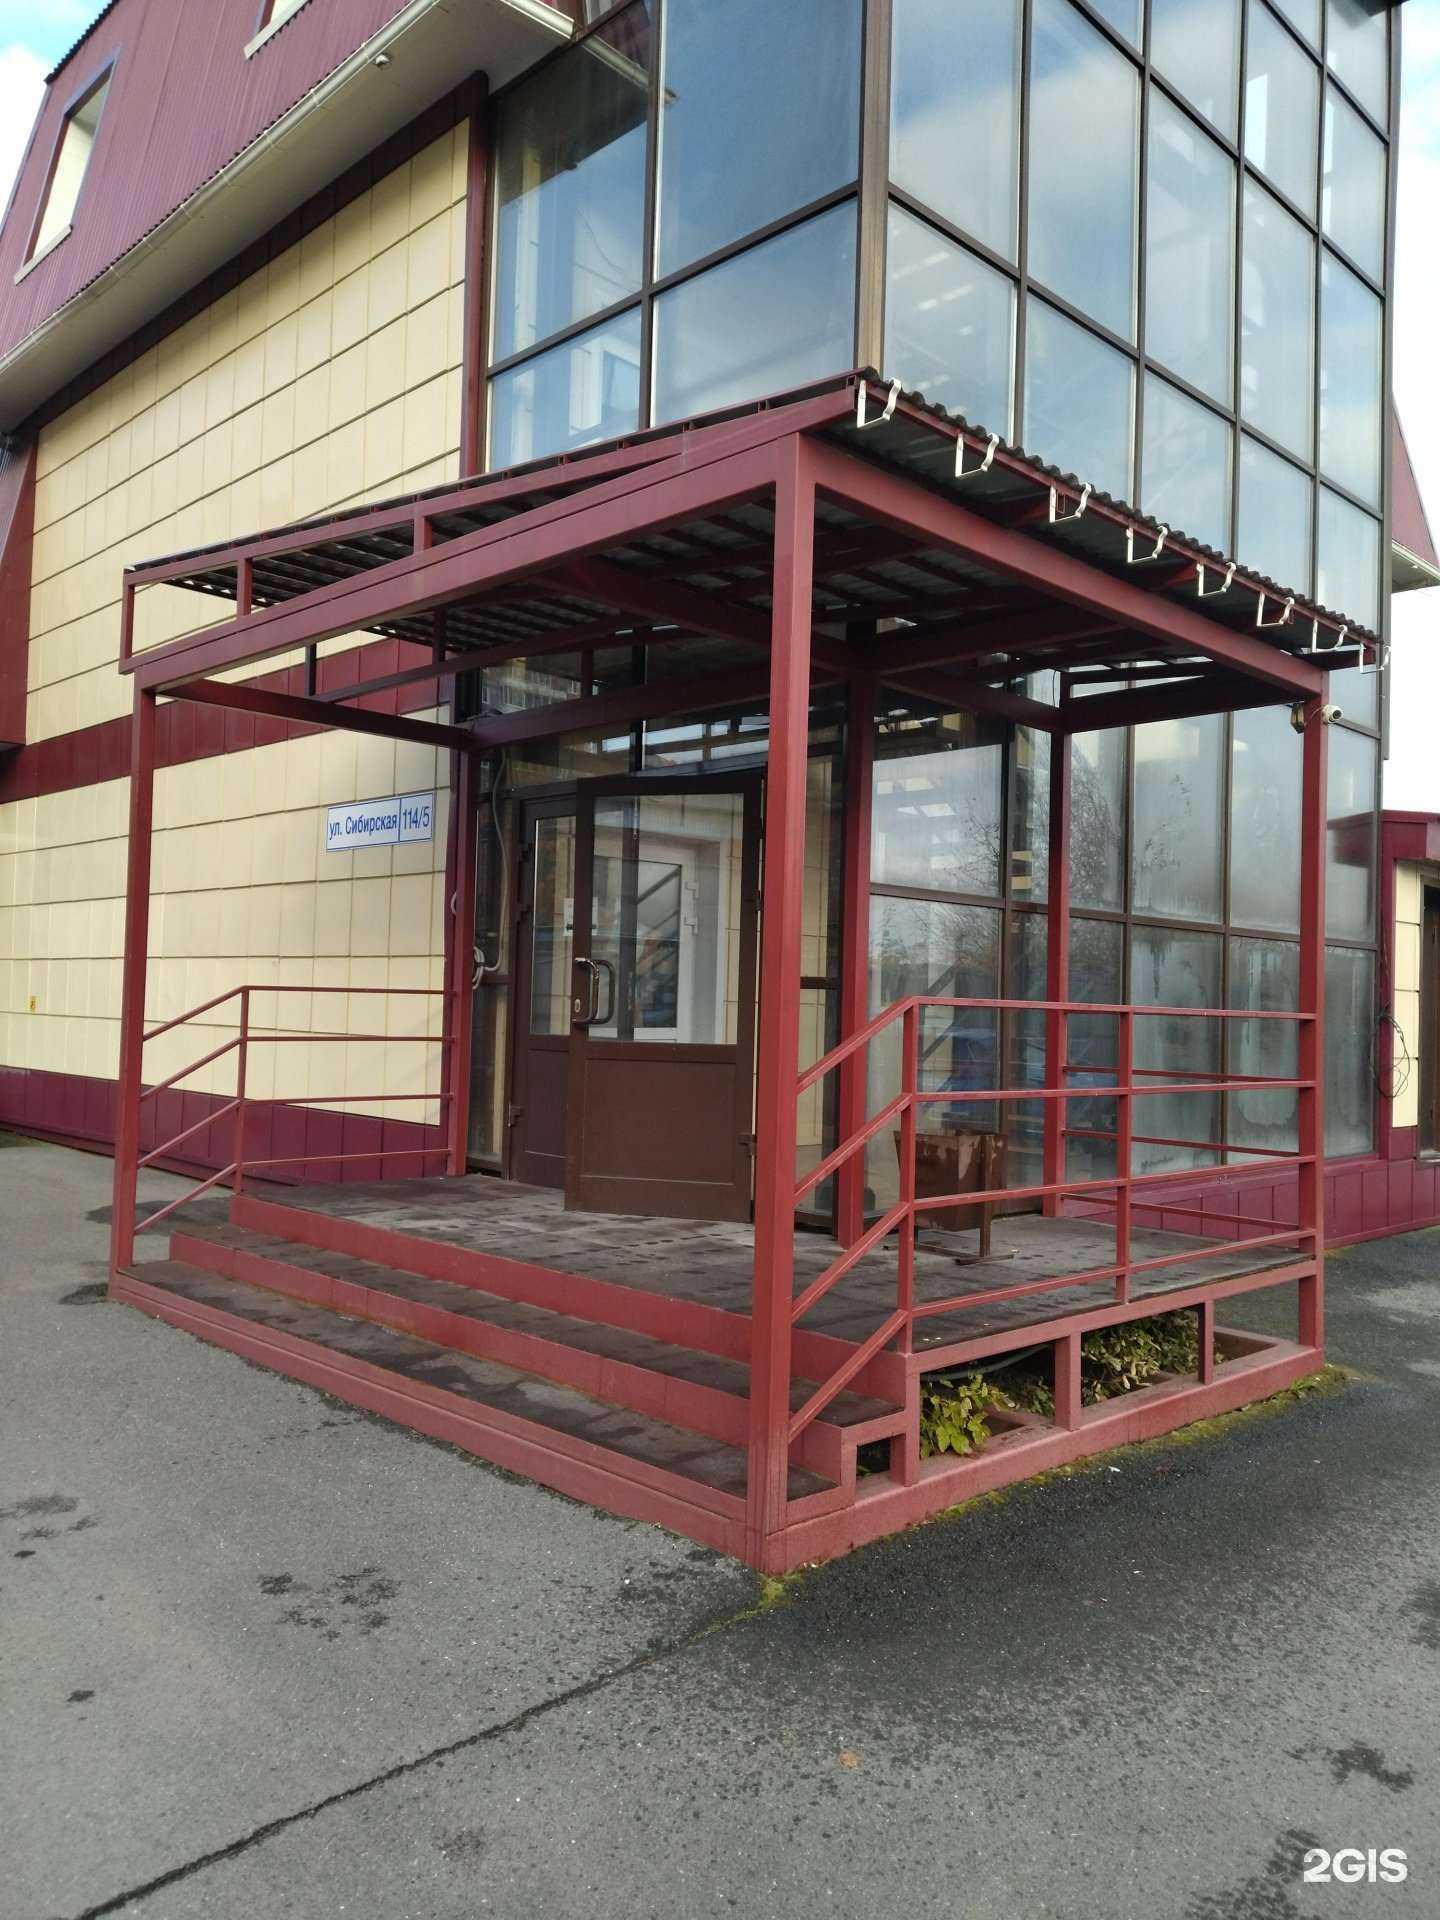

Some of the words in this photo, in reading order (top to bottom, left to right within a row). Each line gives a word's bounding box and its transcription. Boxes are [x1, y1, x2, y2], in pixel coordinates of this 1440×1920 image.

[329, 821, 342, 840] ул.
[345, 814, 398, 836] Сибирская
[402, 806, 430, 830] 114/5
